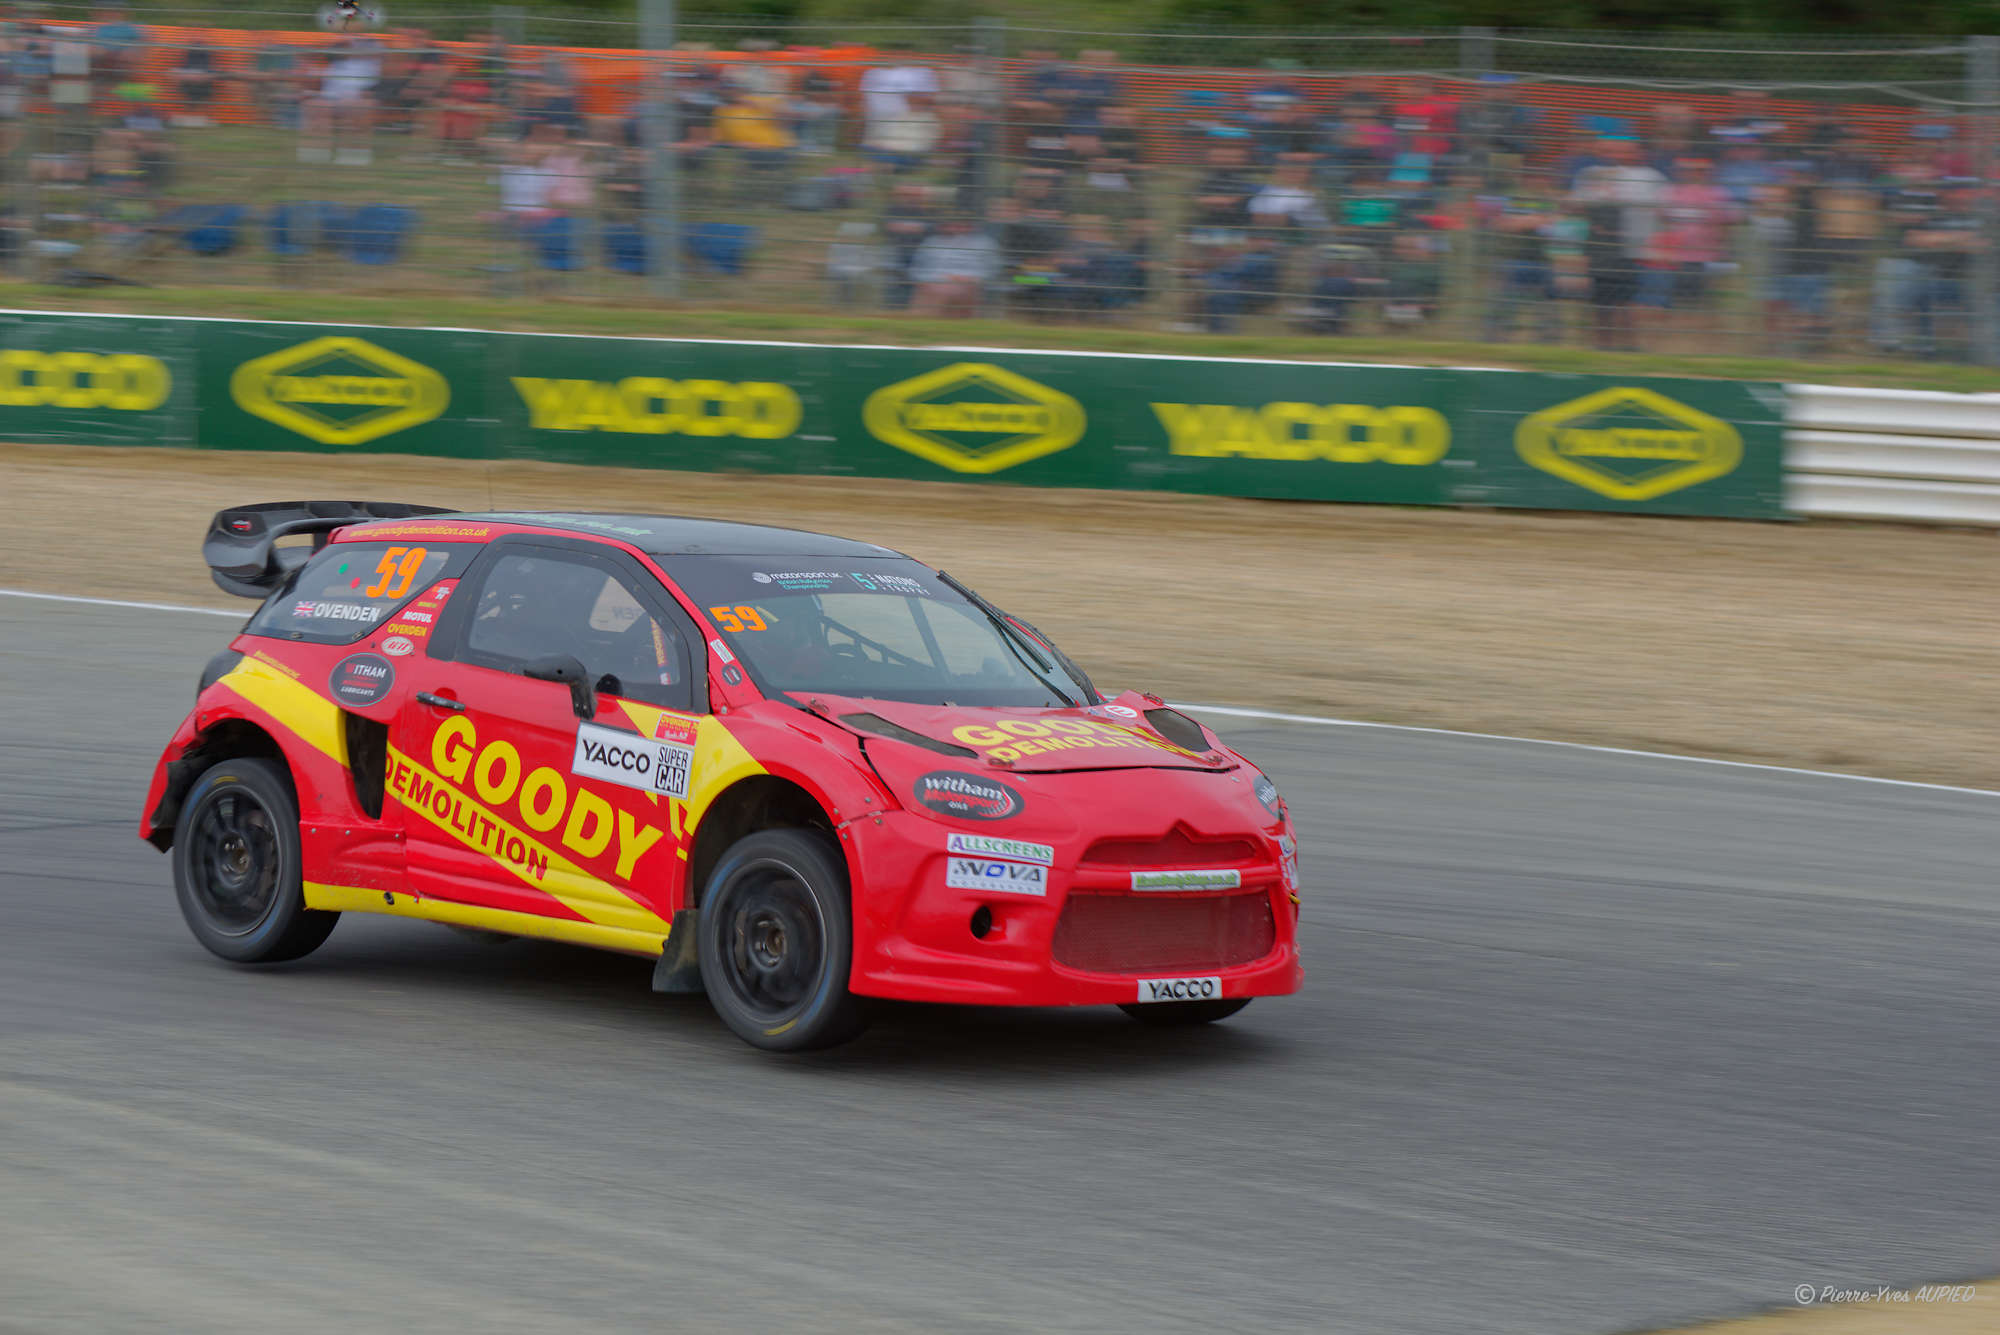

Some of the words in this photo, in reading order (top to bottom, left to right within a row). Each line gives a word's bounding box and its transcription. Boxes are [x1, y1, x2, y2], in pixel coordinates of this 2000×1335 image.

[511, 377, 803, 439] YACCO
[1149, 402, 1451, 466] YACCO
[365, 547, 427, 600] 59
[851, 573, 877, 590] 5
[314, 603, 381, 623] OVENDEN
[709, 606, 768, 633] 59
[583, 739, 651, 774] YACCO
[658, 746, 689, 769] SUPER
[656, 764, 686, 795] CAR
[431, 714, 665, 882] GOODY
[951, 836, 1051, 859] ALLSCREENS
[1148, 980, 1214, 1000] YACCO
